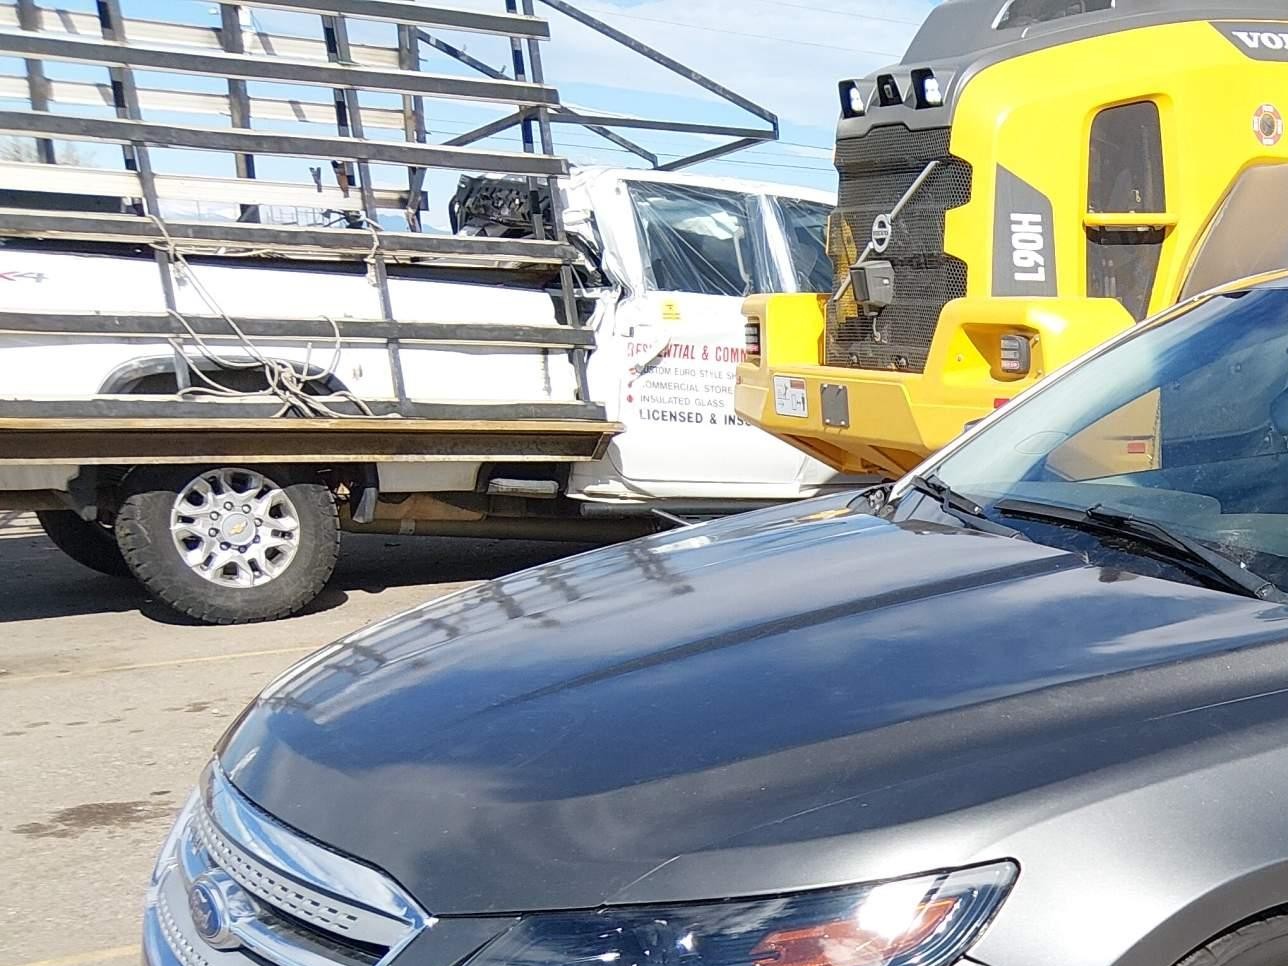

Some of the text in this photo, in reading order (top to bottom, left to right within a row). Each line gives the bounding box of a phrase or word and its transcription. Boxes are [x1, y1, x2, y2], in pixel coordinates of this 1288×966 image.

[1010, 213, 1046, 282] L90H
[701, 345, 709, 360] &
[641, 365, 672, 377] USTOM
[674, 367, 696, 377] EURO
[699, 369, 724, 380] STYLE
[643, 379, 700, 393] OMMERCIAL
[640, 394, 726, 408] INSULATED GLASS
[640, 408, 703, 424] LICENSED
[709, 412, 718, 425] &
